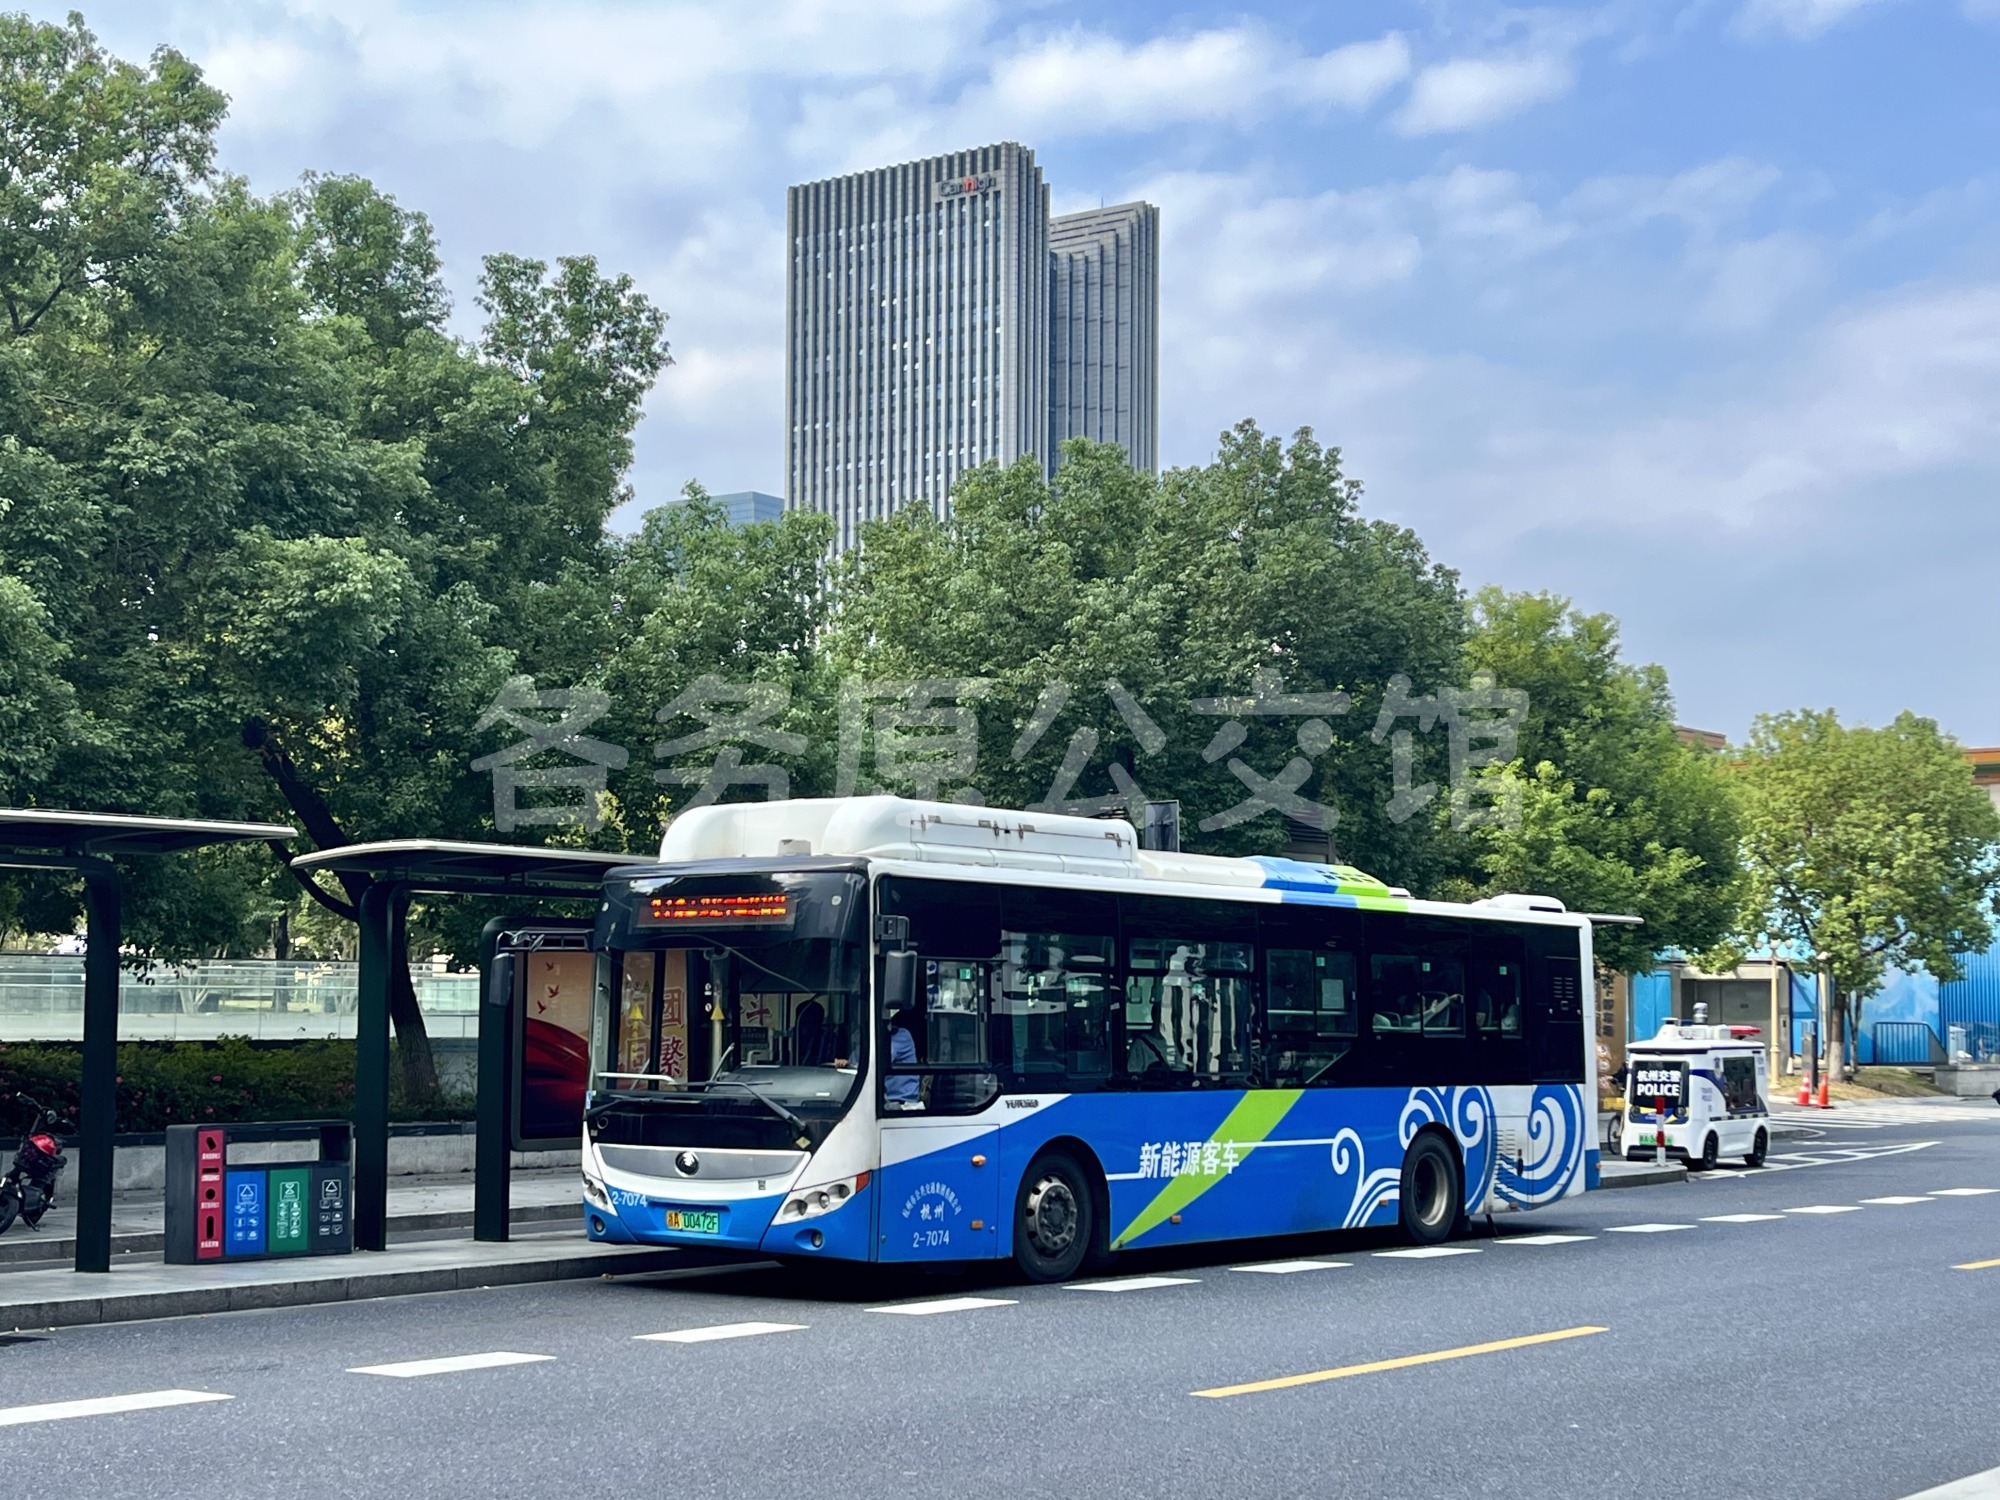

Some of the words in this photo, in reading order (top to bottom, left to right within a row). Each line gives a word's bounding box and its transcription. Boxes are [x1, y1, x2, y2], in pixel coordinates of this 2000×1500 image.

[939, 175, 996, 195] Canhigh
[1636, 1070, 1682, 1082] 杭州交警
[1636, 1083, 1680, 1096] POLICE
[1139, 1139, 1240, 1179] 新能源客车
[611, 1190, 648, 1208] 2-7074
[919, 1200, 945, 1222] 杭州
[912, 1229, 950, 1248] 2-7074
